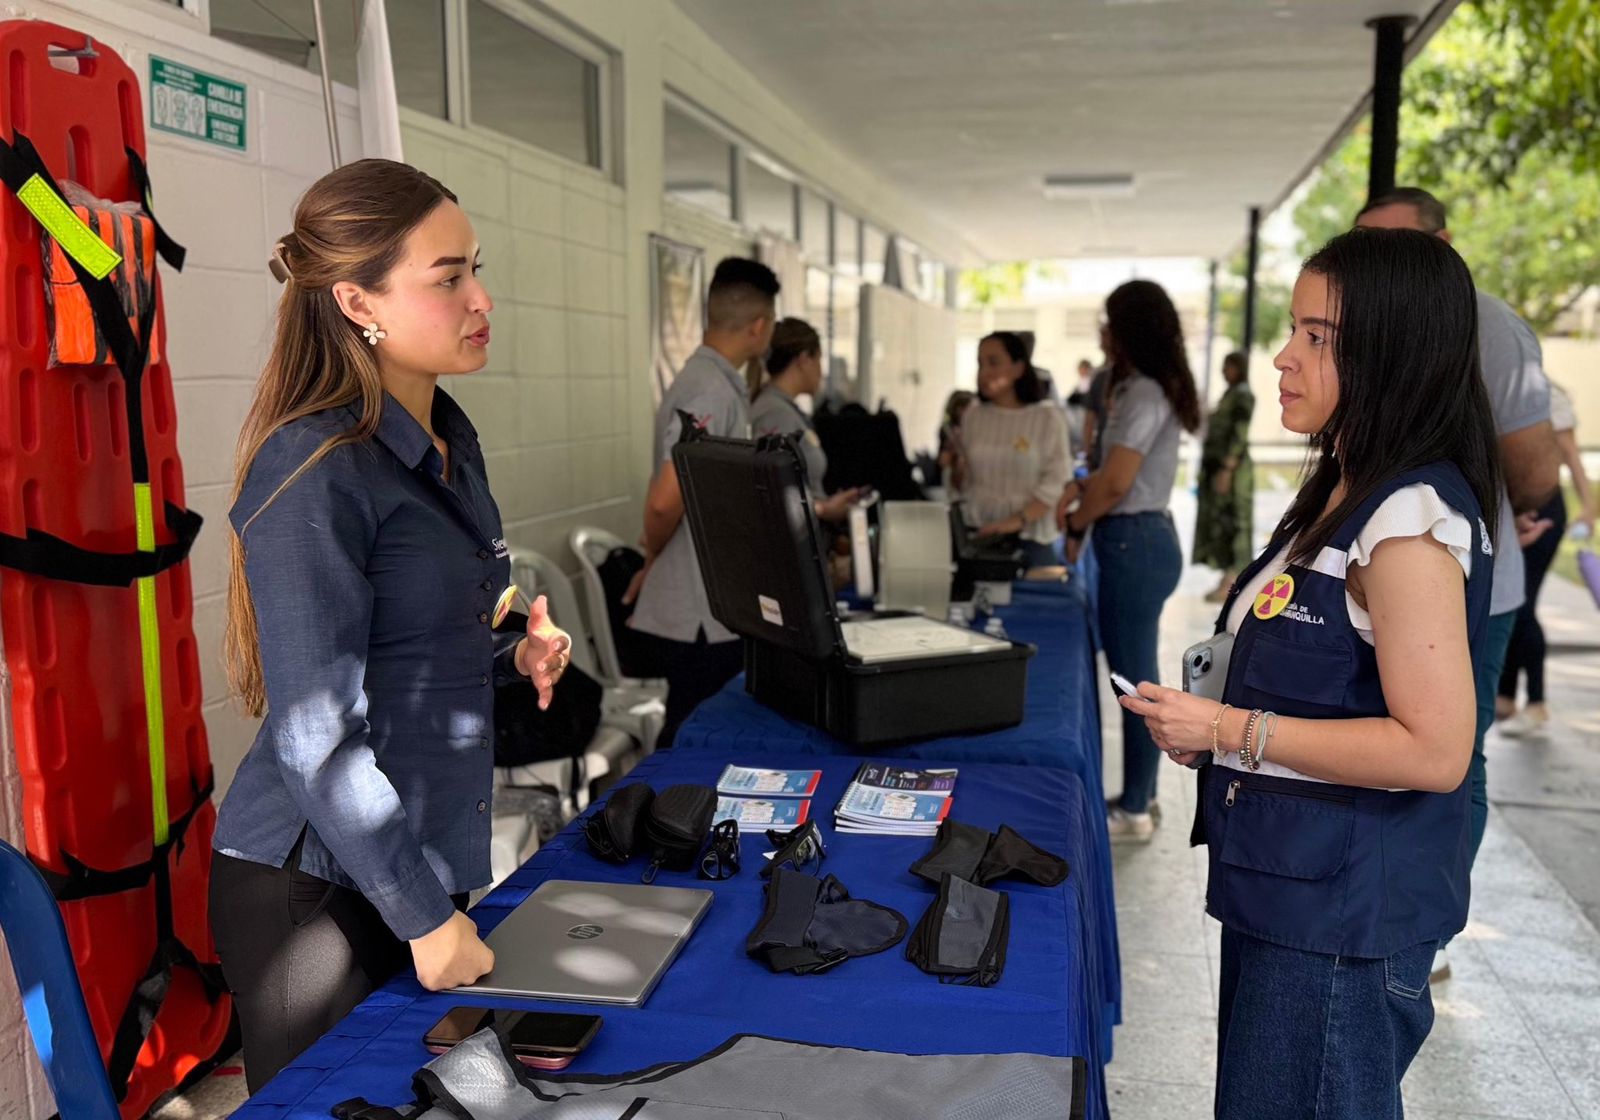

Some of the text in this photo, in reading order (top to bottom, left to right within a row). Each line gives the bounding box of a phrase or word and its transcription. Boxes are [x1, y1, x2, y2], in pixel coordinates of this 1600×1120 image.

[234, 89, 242, 105] DE
[207, 98, 243, 119] EMERGENCIA
[1300, 605, 1308, 614] DE
[570, 926, 602, 939] hp
